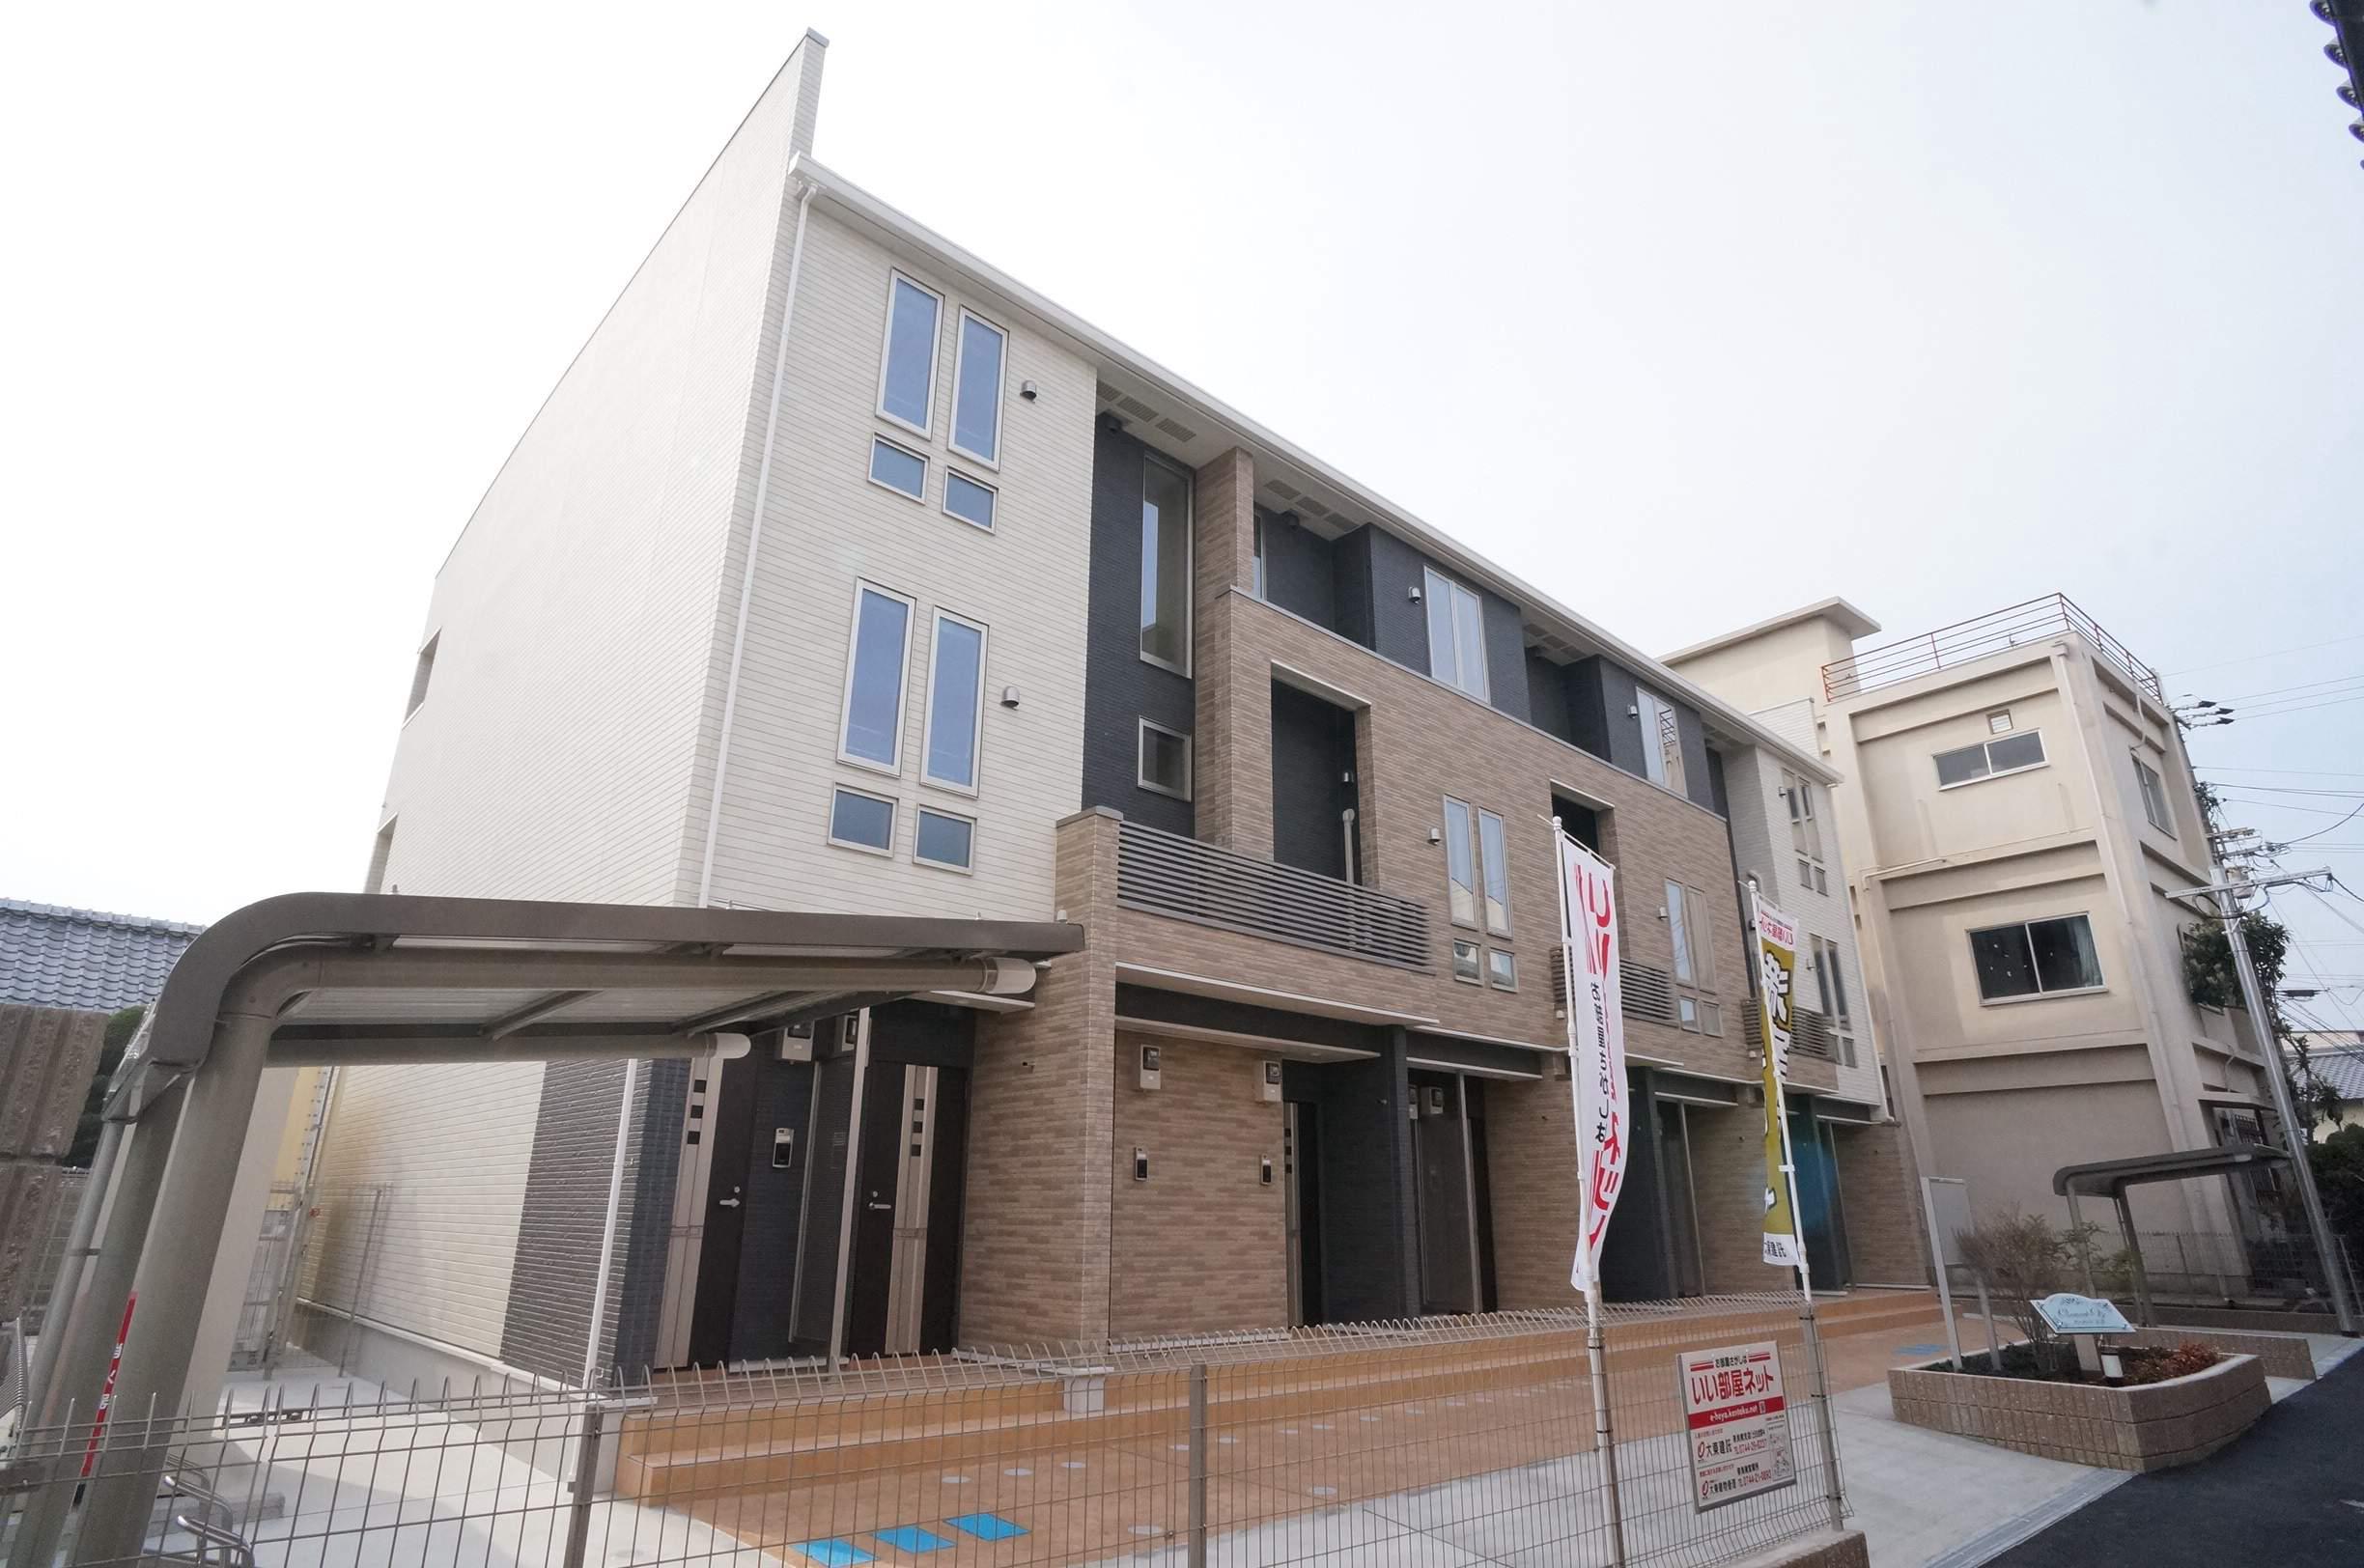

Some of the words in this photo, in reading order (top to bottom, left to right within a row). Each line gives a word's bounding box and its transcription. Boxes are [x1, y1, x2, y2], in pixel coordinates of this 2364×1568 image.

[1715, 1356, 1748, 1368] お部屋さがしは
[1691, 1364, 1774, 1405] いい部屋ネット
[1705, 1439, 1732, 1457] 大東建託
